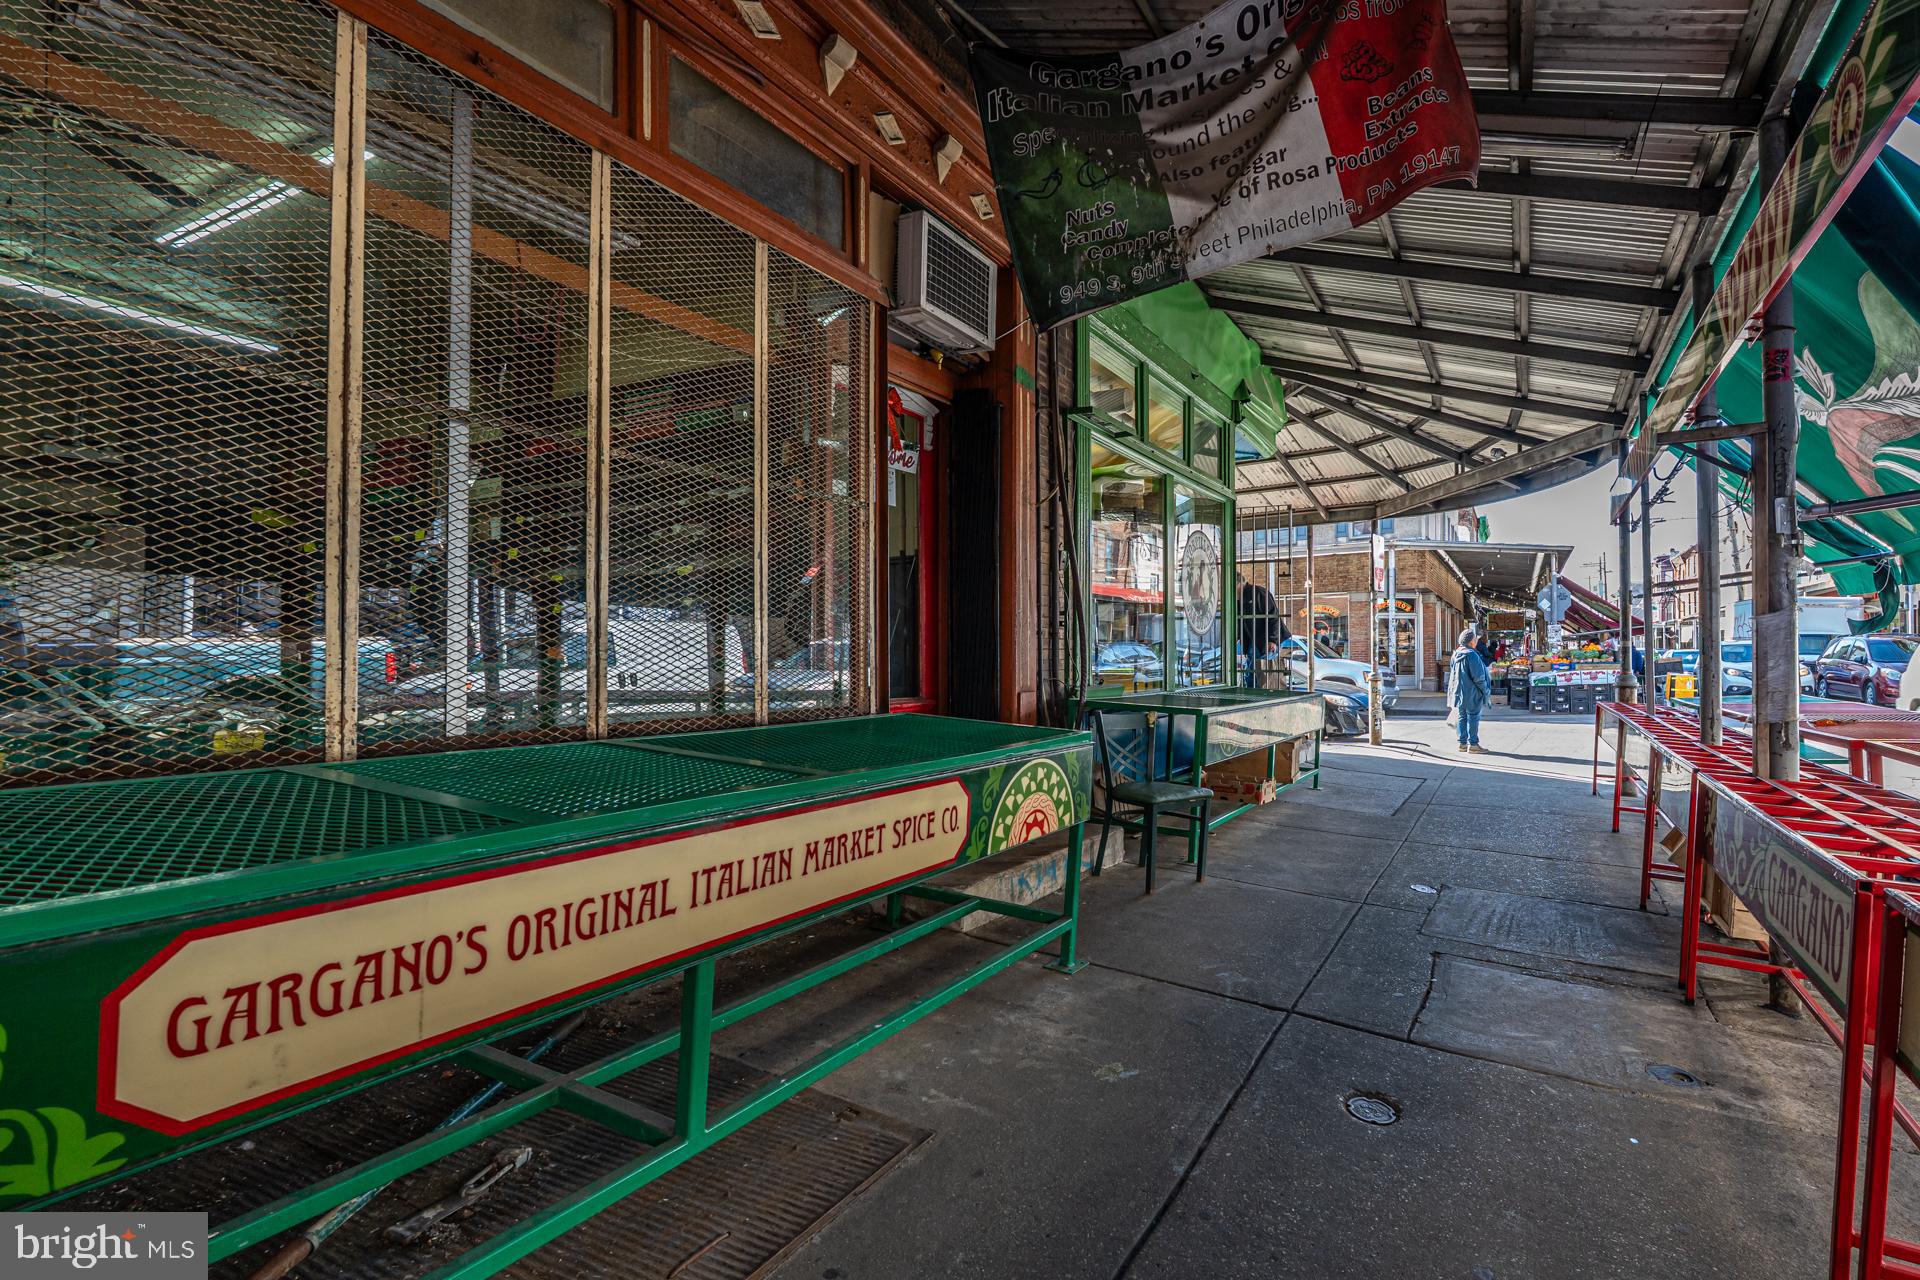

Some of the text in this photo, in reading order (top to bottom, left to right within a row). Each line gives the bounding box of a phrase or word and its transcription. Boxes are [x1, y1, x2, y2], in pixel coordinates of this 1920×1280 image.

[1030, 33, 1225, 91] Gargano's
[1274, 59, 1294, 80] &
[987, 87, 1111, 122] Italian
[1121, 55, 1256, 115] Market
[1364, 87, 1449, 141] Extracts
[1367, 66, 1433, 116] Beans
[1216, 109, 1256, 137] the
[1087, 224, 1190, 261] Complete
[1238, 176, 1260, 199] of
[1267, 164, 1319, 191] Rosa
[1325, 122, 1418, 174] Products
[1160, 166, 1204, 184] Also
[1060, 277, 1101, 304] 949
[1131, 258, 1166, 285] 9th
[1237, 198, 1363, 244] Philadelphia,
[1366, 177, 1396, 206] PA
[1400, 145, 1460, 184] 19147
[1061, 219, 1128, 247] Candy
[1066, 201, 1116, 227] Nuts
[166, 806, 960, 1059] GARGANO'S ORIGINAL ITALIAN MARKET SPICE CO.
